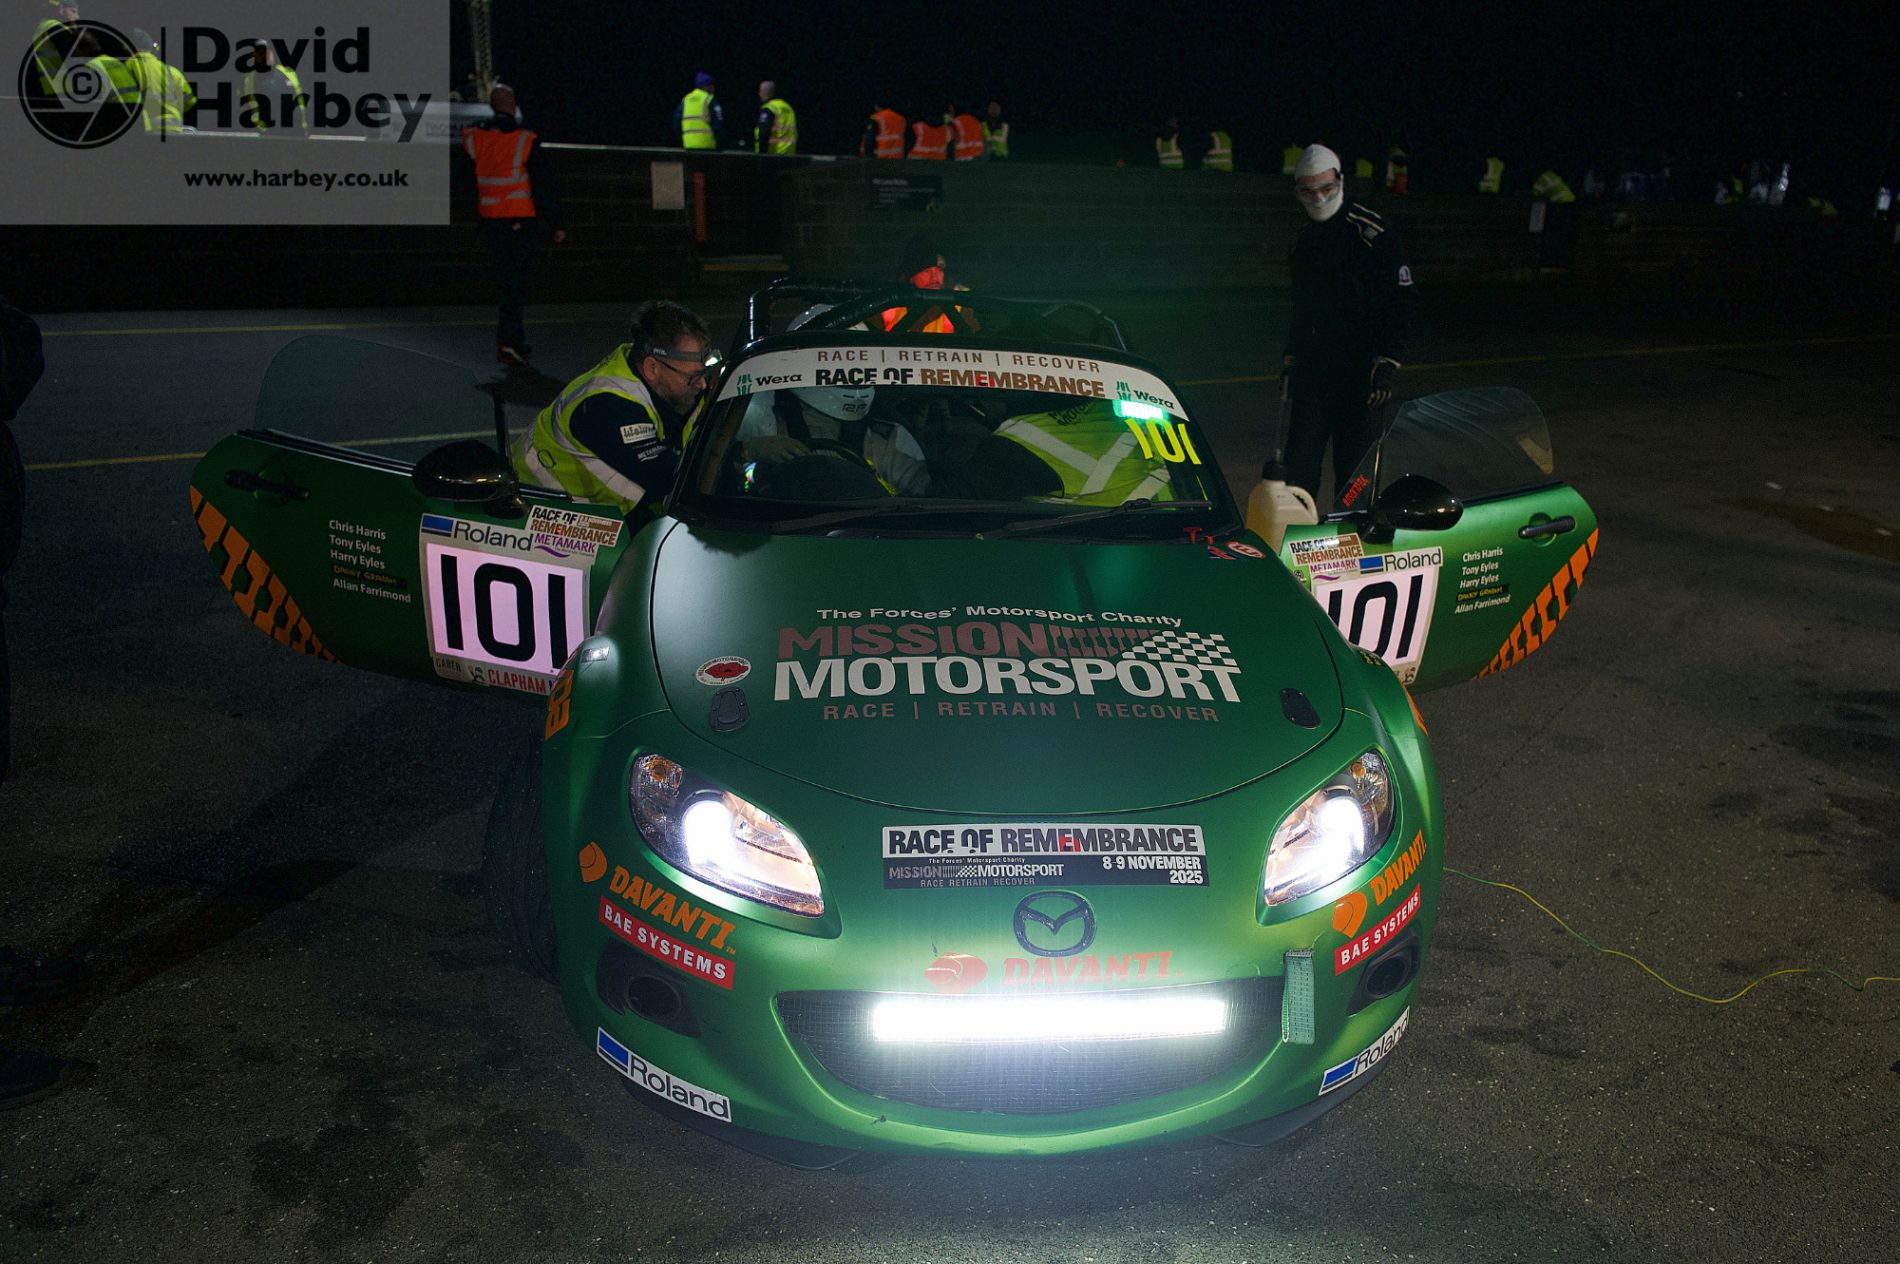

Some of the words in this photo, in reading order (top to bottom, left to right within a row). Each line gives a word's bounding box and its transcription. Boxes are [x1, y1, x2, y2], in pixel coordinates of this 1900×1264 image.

[818, 350, 869, 362] RACE
[899, 350, 983, 363] RETRAIN
[1013, 354, 1100, 373] RECOVER
[755, 374, 802, 386] Wera
[816, 368, 878, 386] RACE
[883, 368, 913, 385] OF
[920, 368, 1106, 398] REMEMBRANCE
[1134, 389, 1175, 409] Wera
[1124, 417, 1202, 465] 101
[532, 507, 562, 523] RACE
[562, 512, 578, 525] OF
[329, 520, 354, 533] Chris
[356, 525, 386, 540] Harris
[453, 520, 533, 552] Roland
[530, 519, 617, 545] REMEMBRANCE
[329, 534, 354, 549] Tony
[355, 539, 381, 554] Eyles
[534, 533, 596, 553] METAMARK
[1462, 551, 1481, 562] Chris
[1481, 546, 1504, 558] Harris
[330, 549, 357, 565] Harry
[359, 555, 385, 569] Eyles
[1296, 545, 1363, 565] REMEMBRANCE
[1310, 558, 1358, 573] METAMARK
[1384, 548, 1442, 572] Roland
[1462, 565, 1480, 576] Tony
[1480, 561, 1499, 573] Eyles
[333, 578, 358, 591] Allan
[360, 584, 411, 603] Farrimond
[1459, 577, 1480, 589] Harry
[1480, 573, 1500, 586] Eyles
[440, 553, 568, 670] 101
[817, 608, 862, 620] The
[965, 606, 1096, 623] Motorsport
[1101, 611, 1181, 628] Charity
[1328, 574, 1424, 660] 101
[1454, 604, 1474, 615] Allan
[779, 621, 1052, 659] MISSION
[487, 668, 547, 695] CLAPHAM
[774, 656, 1241, 702] MOTORSPORT
[823, 703, 895, 720] RACE
[938, 702, 1057, 717] RETRAIN
[1096, 703, 1220, 721] RECOVER
[888, 829, 955, 854] RACE
[960, 829, 993, 854] OF
[1000, 827, 1199, 853] REMEMBRANCE
[888, 865, 941, 880] MISSION
[977, 864, 1065, 878] MOTORSPORT
[1102, 856, 1126, 870] 8-9
[1127, 856, 1202, 870] NOVEMBER
[1370, 829, 1427, 906] DAVANTI
[920, 879, 944, 887] RACE
[949, 878, 988, 887] RETRAIN
[994, 877, 1035, 886] RECOVER
[1169, 869, 1203, 884] 2025
[610, 865, 735, 949] DAVANTI
[1341, 937, 1369, 965] BAE
[1374, 891, 1419, 945] SYSTEMS
[605, 904, 633, 935] BAE
[638, 927, 726, 980] SYSTEMS
[1003, 951, 1172, 982] DAVANTI
[1355, 1009, 1409, 1074] Roland
[630, 1055, 729, 1119] Roland
